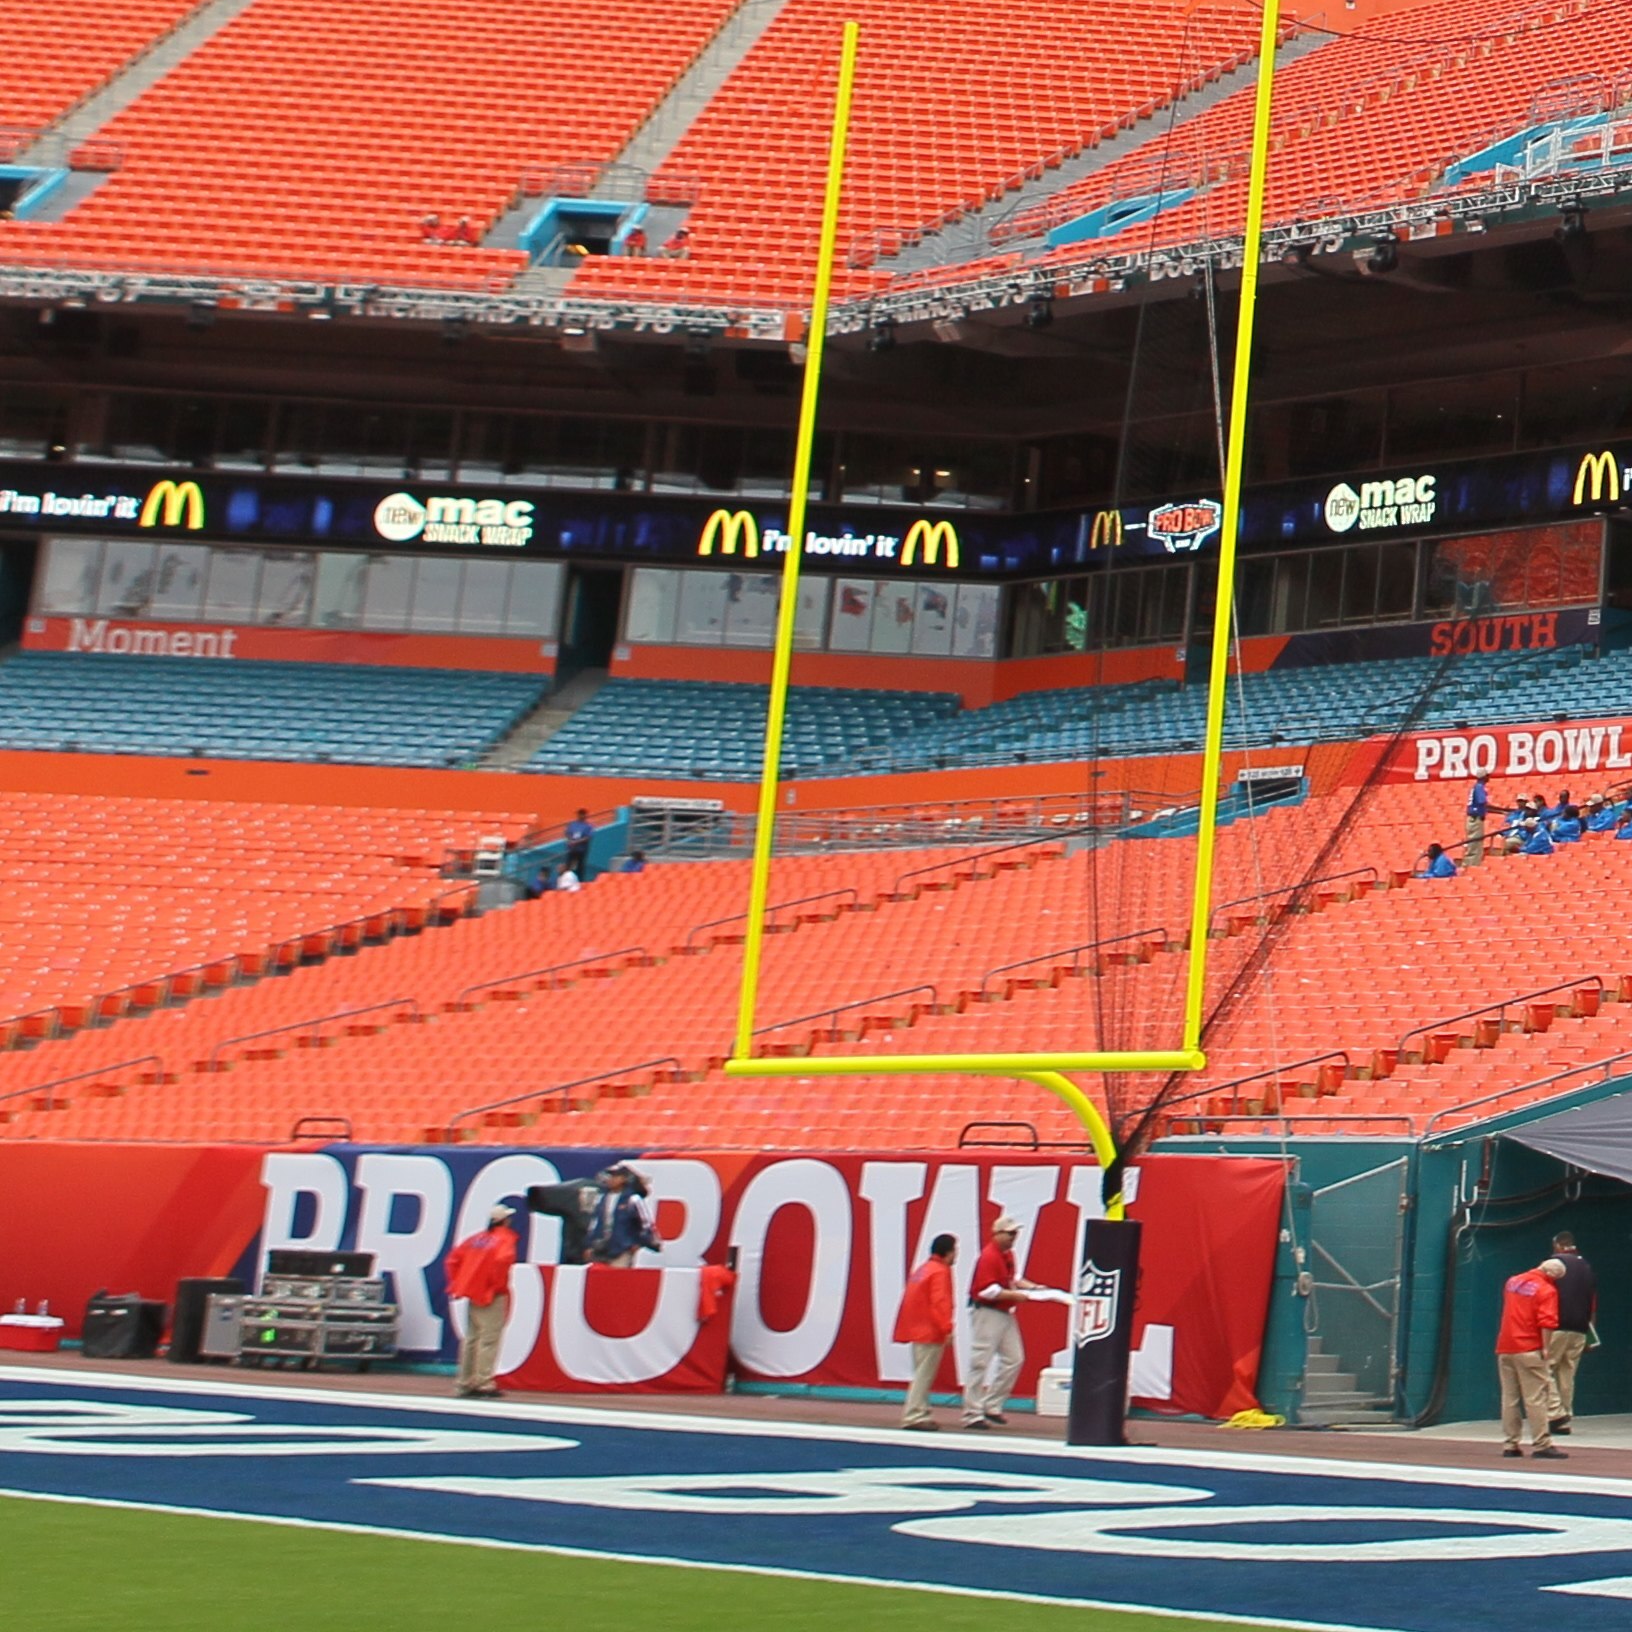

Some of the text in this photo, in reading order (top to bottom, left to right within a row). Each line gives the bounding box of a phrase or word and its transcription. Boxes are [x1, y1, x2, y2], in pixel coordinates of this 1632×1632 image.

[424, 496, 537, 528] mac
[1329, 475, 1436, 518] new mac
[1359, 501, 1436, 530] SNACK WRAP
[65, 618, 239, 658] Moment
[1430, 611, 1558, 658] SOUTH
[1415, 734, 1498, 780] PRO
